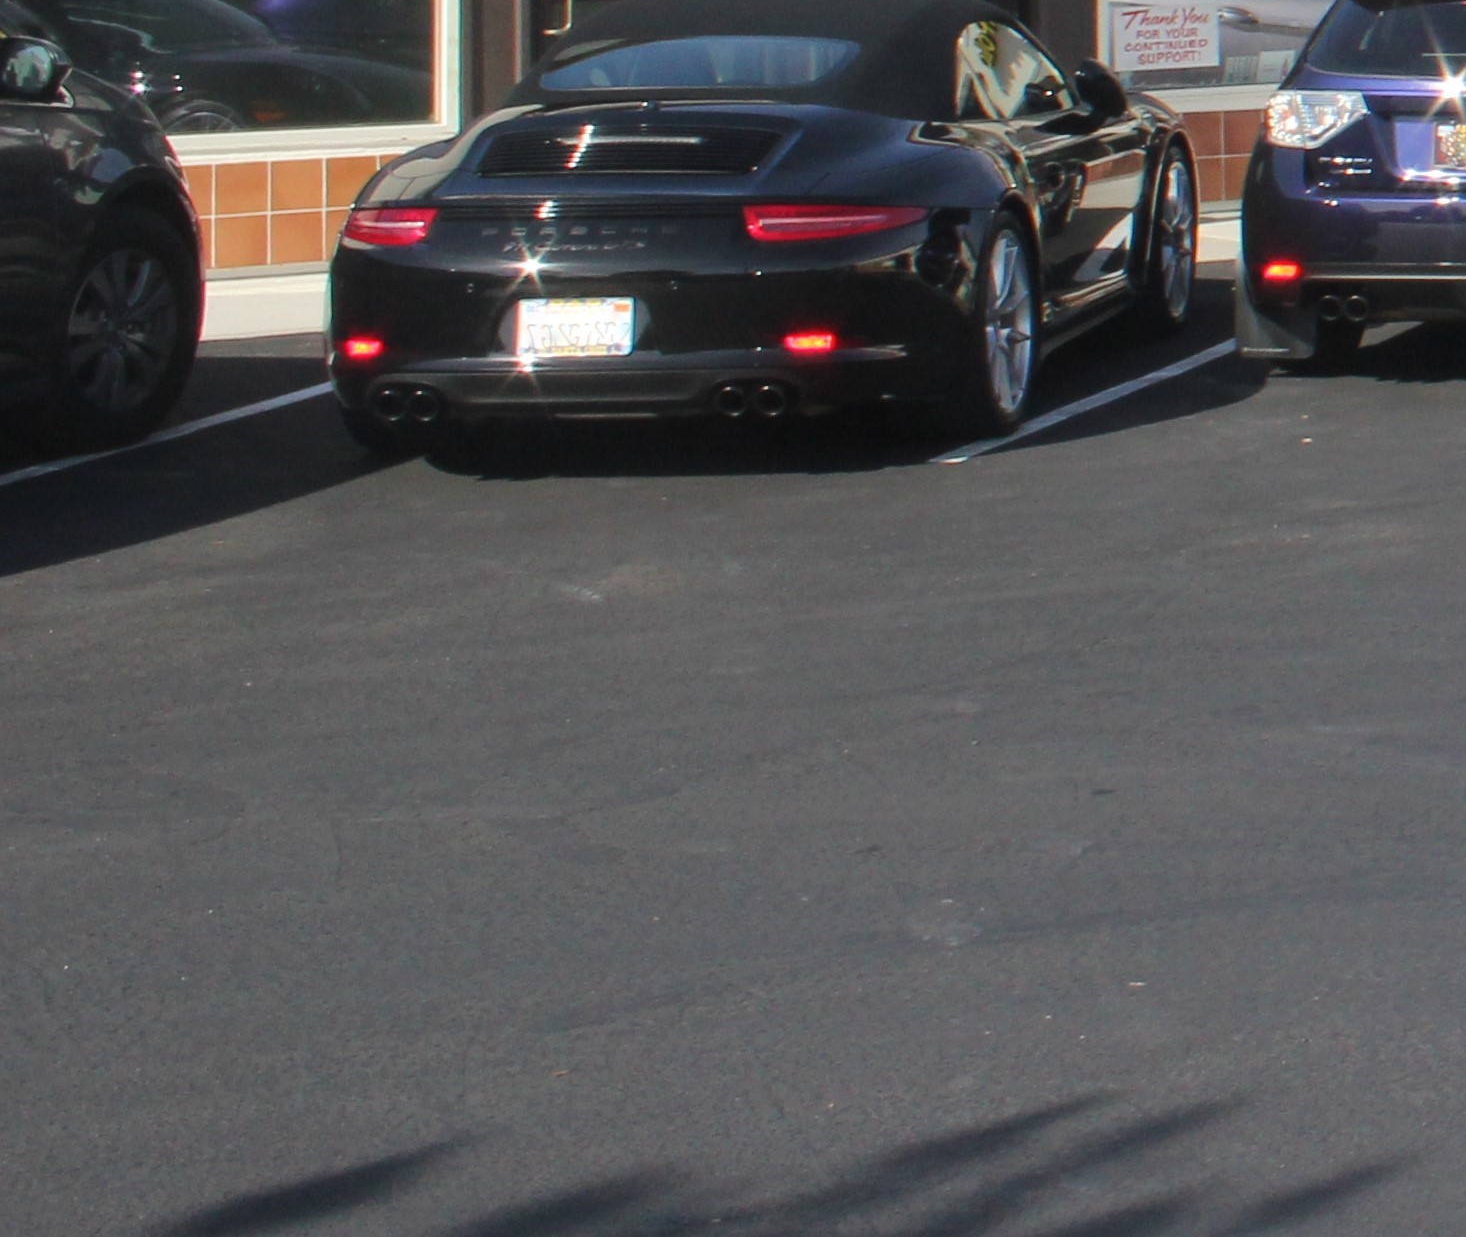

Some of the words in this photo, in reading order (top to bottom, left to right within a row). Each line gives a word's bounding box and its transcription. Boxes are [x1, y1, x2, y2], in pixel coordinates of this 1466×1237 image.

[1121, 8, 1177, 31] Thank
[1180, 7, 1209, 31] You
[1136, 30, 1160, 40] FOR
[1166, 28, 1198, 38] YOUR
[1124, 39, 1208, 53] CONTINUED
